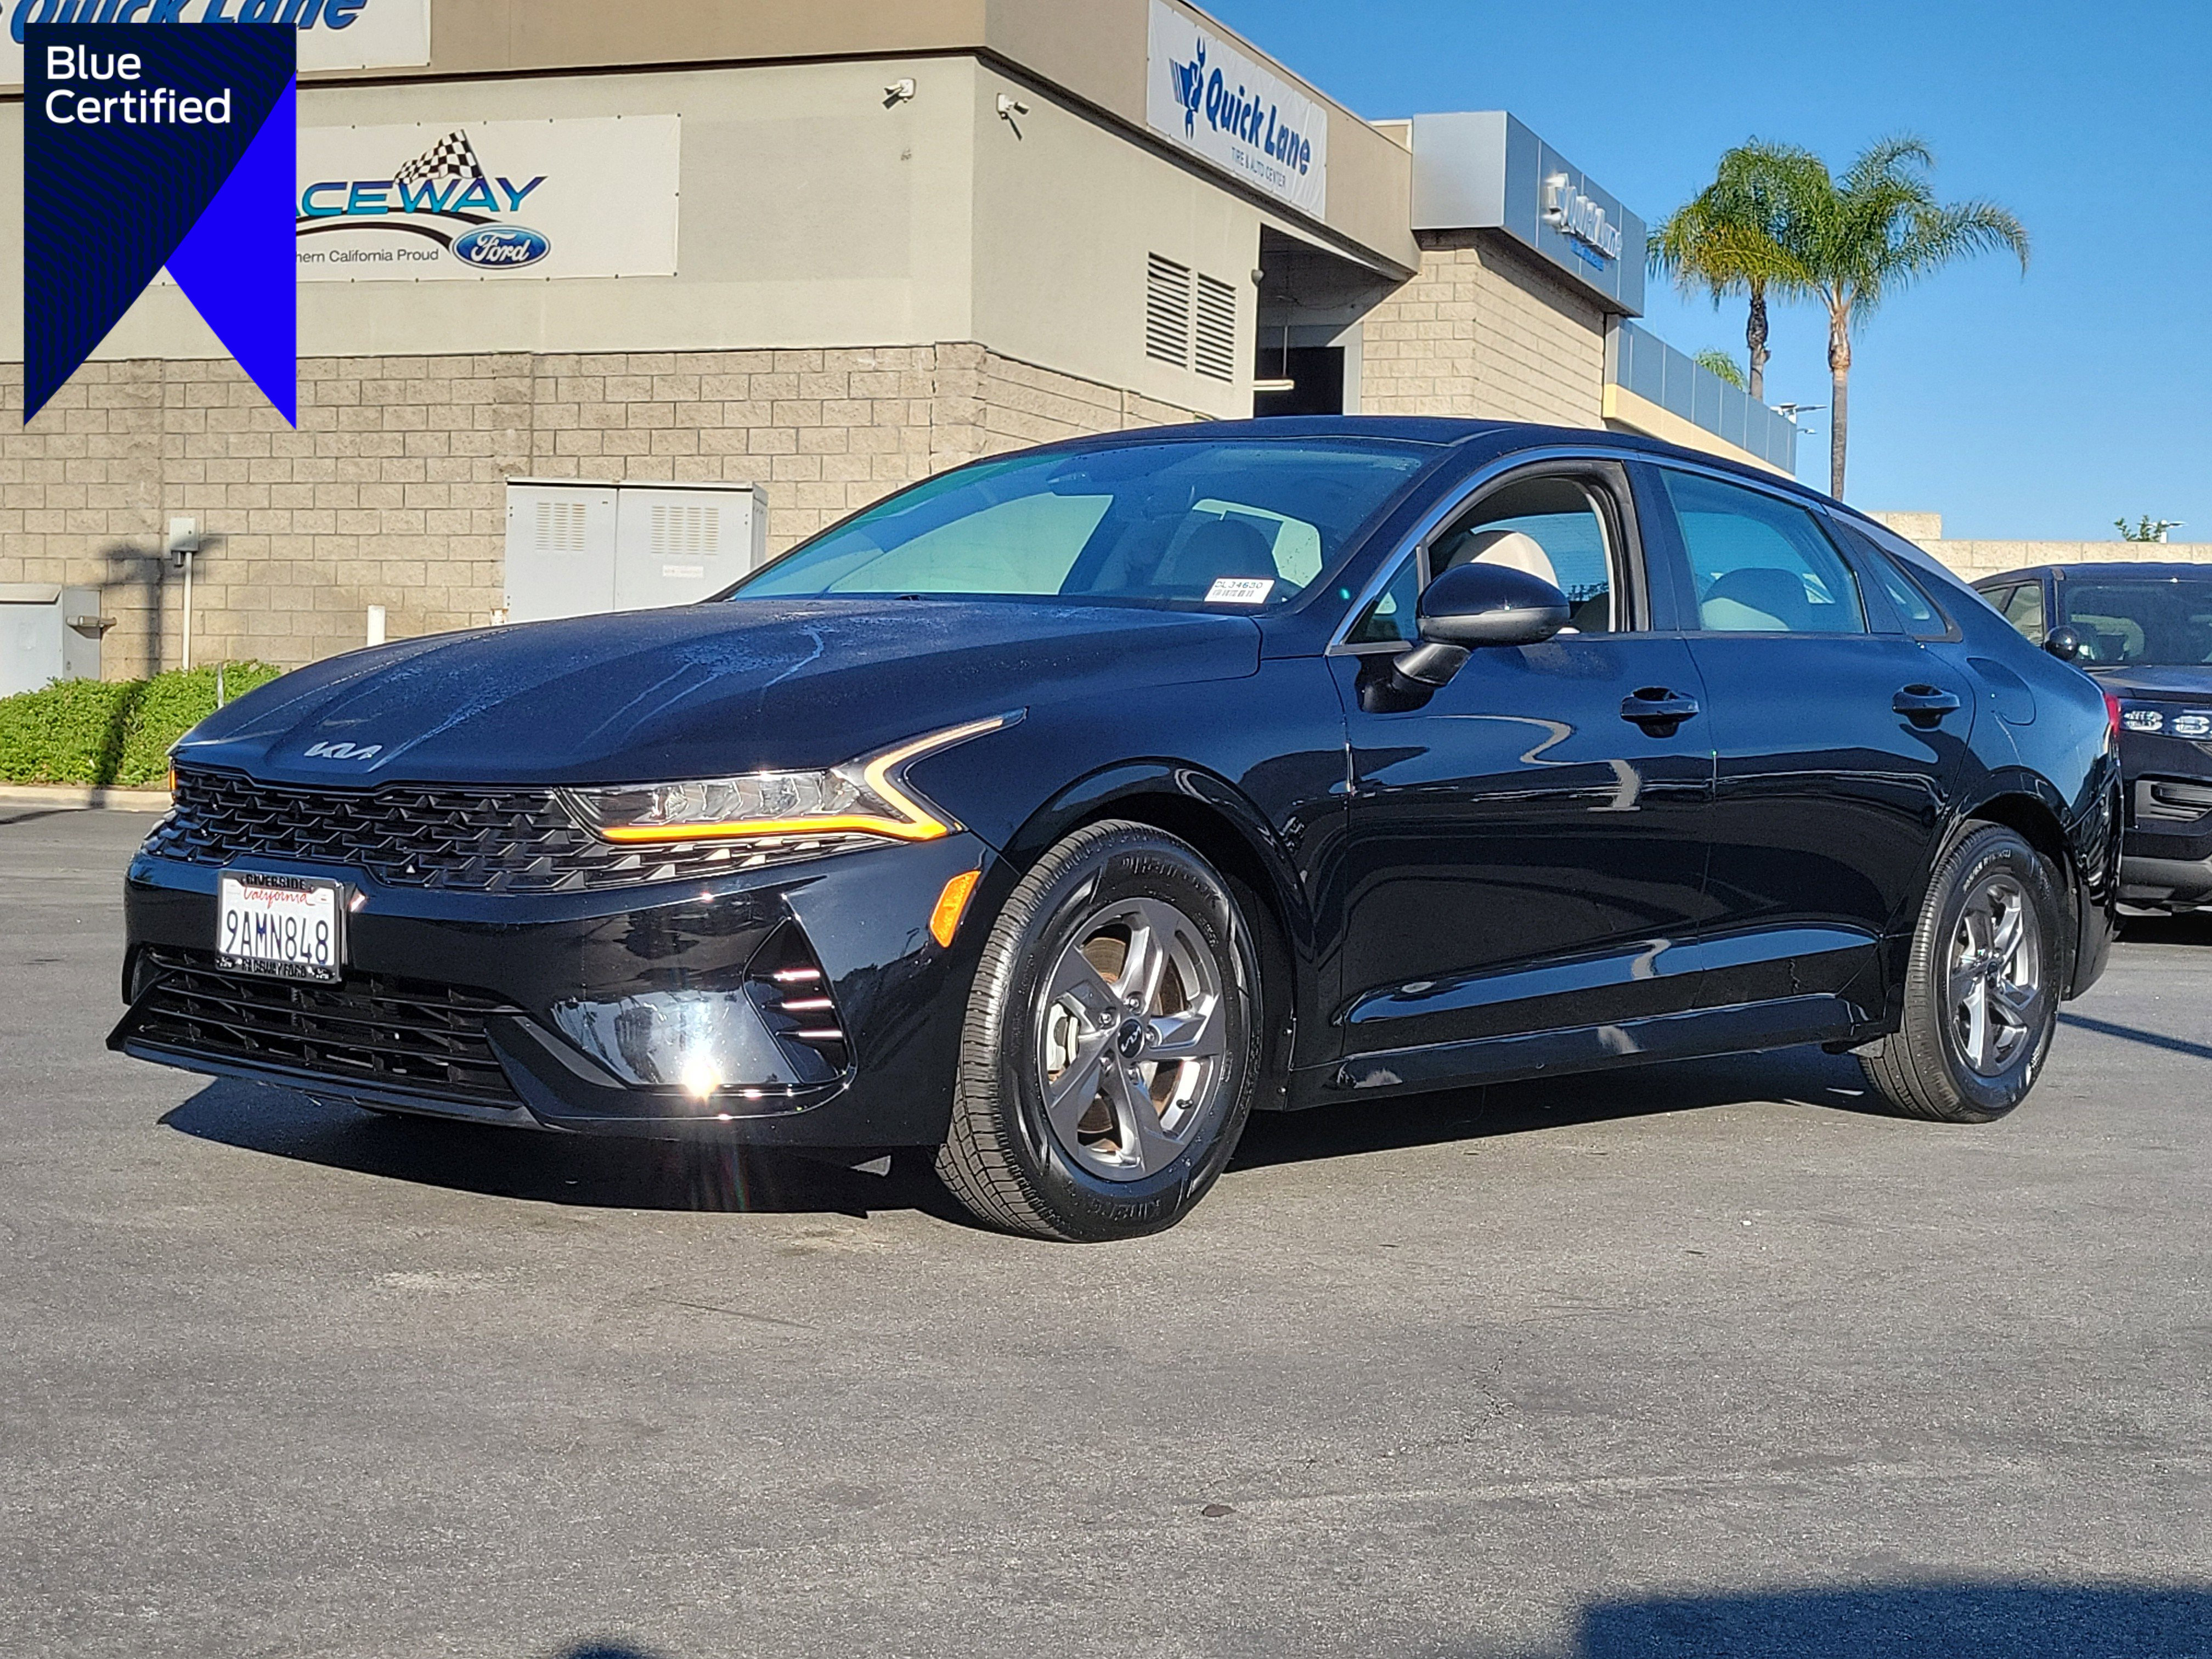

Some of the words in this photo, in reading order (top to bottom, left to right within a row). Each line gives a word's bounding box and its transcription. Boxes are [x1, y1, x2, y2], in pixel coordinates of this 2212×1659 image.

[1206, 67, 1264, 149] Quick
[1264, 104, 1310, 176] Lane
[296, 175, 549, 216] CEWAY
[329, 248, 393, 262] California
[397, 248, 439, 261] Proud
[470, 232, 532, 263] Ford
[304, 741, 383, 760] KIA
[244, 887, 316, 909] California
[225, 909, 329, 965] 9AMN848
